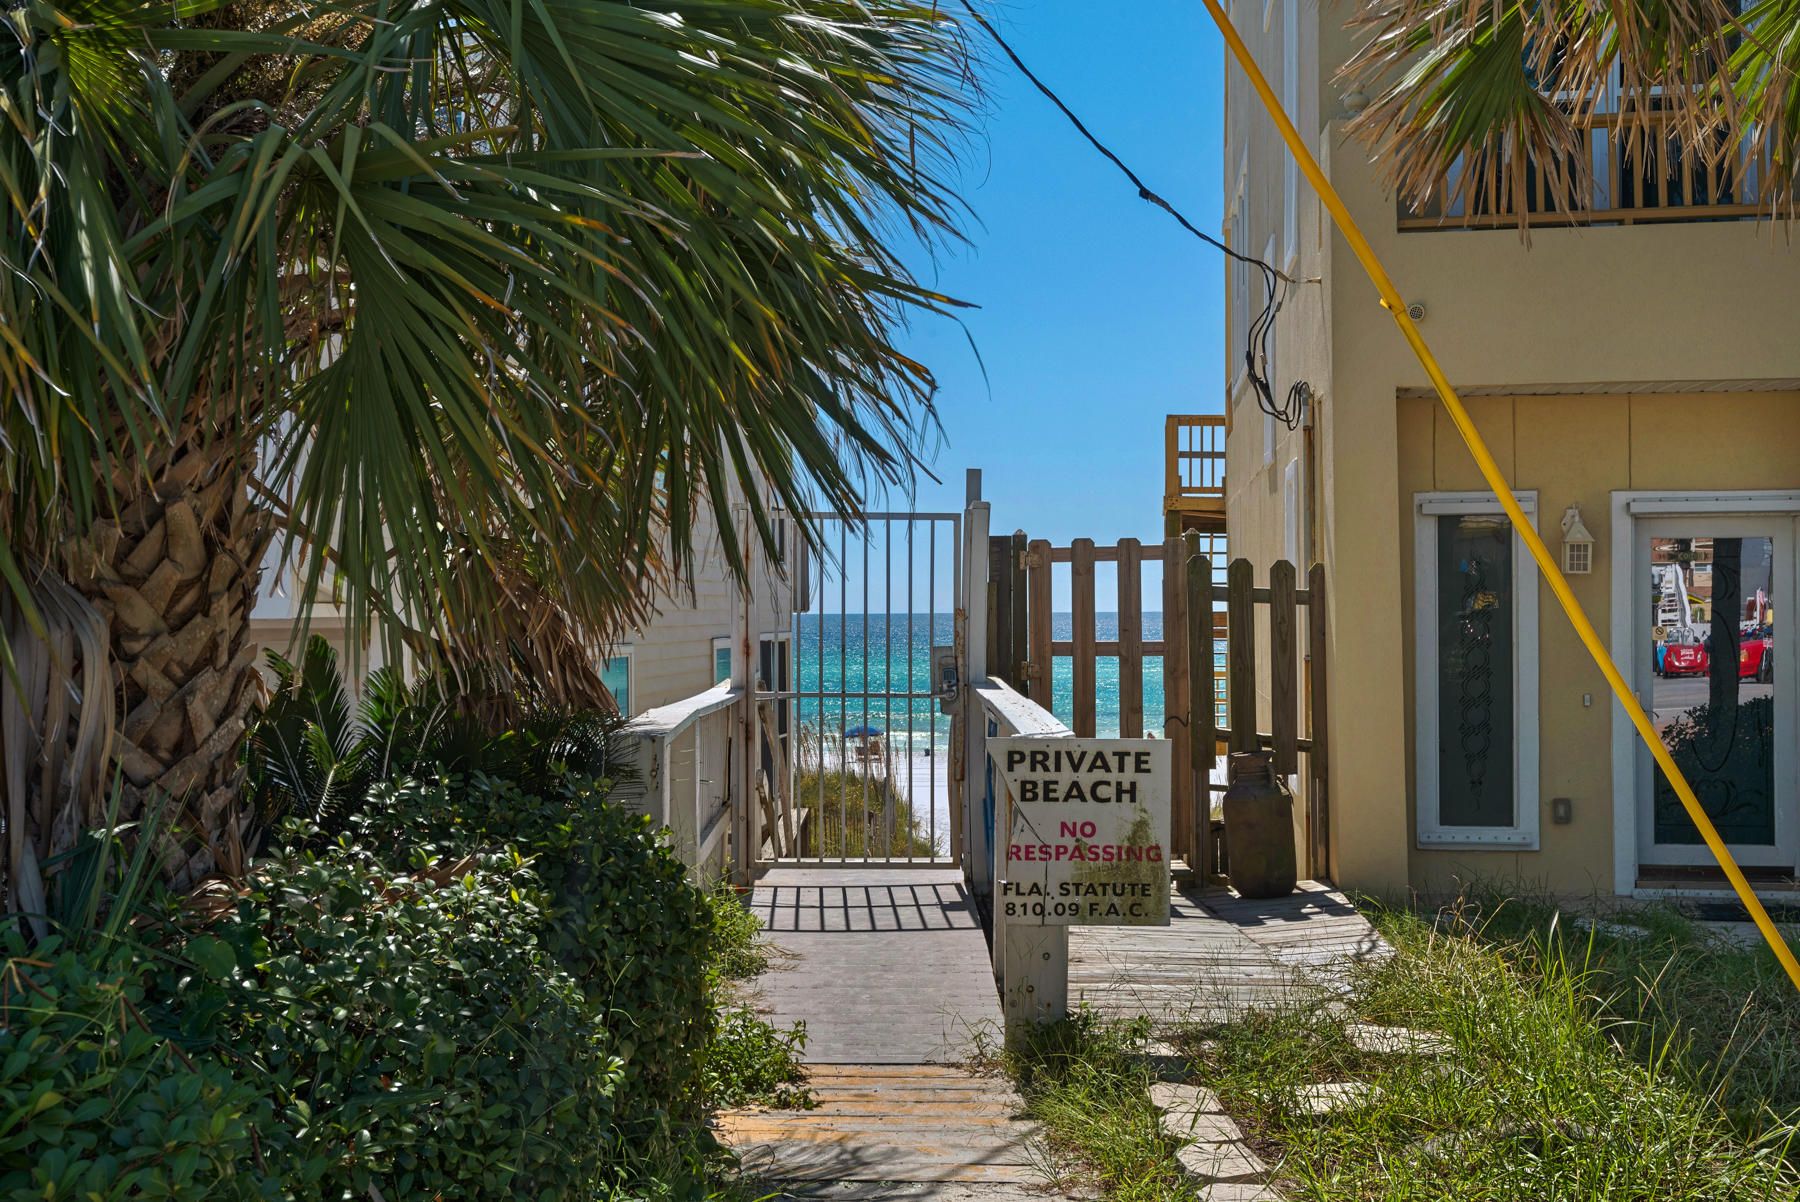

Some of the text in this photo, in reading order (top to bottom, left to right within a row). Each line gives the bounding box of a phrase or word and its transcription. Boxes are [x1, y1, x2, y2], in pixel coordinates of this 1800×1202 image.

[1007, 750, 1152, 773] PRIVATE
[1020, 780, 1137, 803] BEACH
[1060, 821, 1097, 838] NO
[1009, 844, 1162, 862] RESPASSING
[1003, 882, 1152, 897] FLA. STATUTE
[1005, 902, 1149, 917] 810.09 F.A.C.
